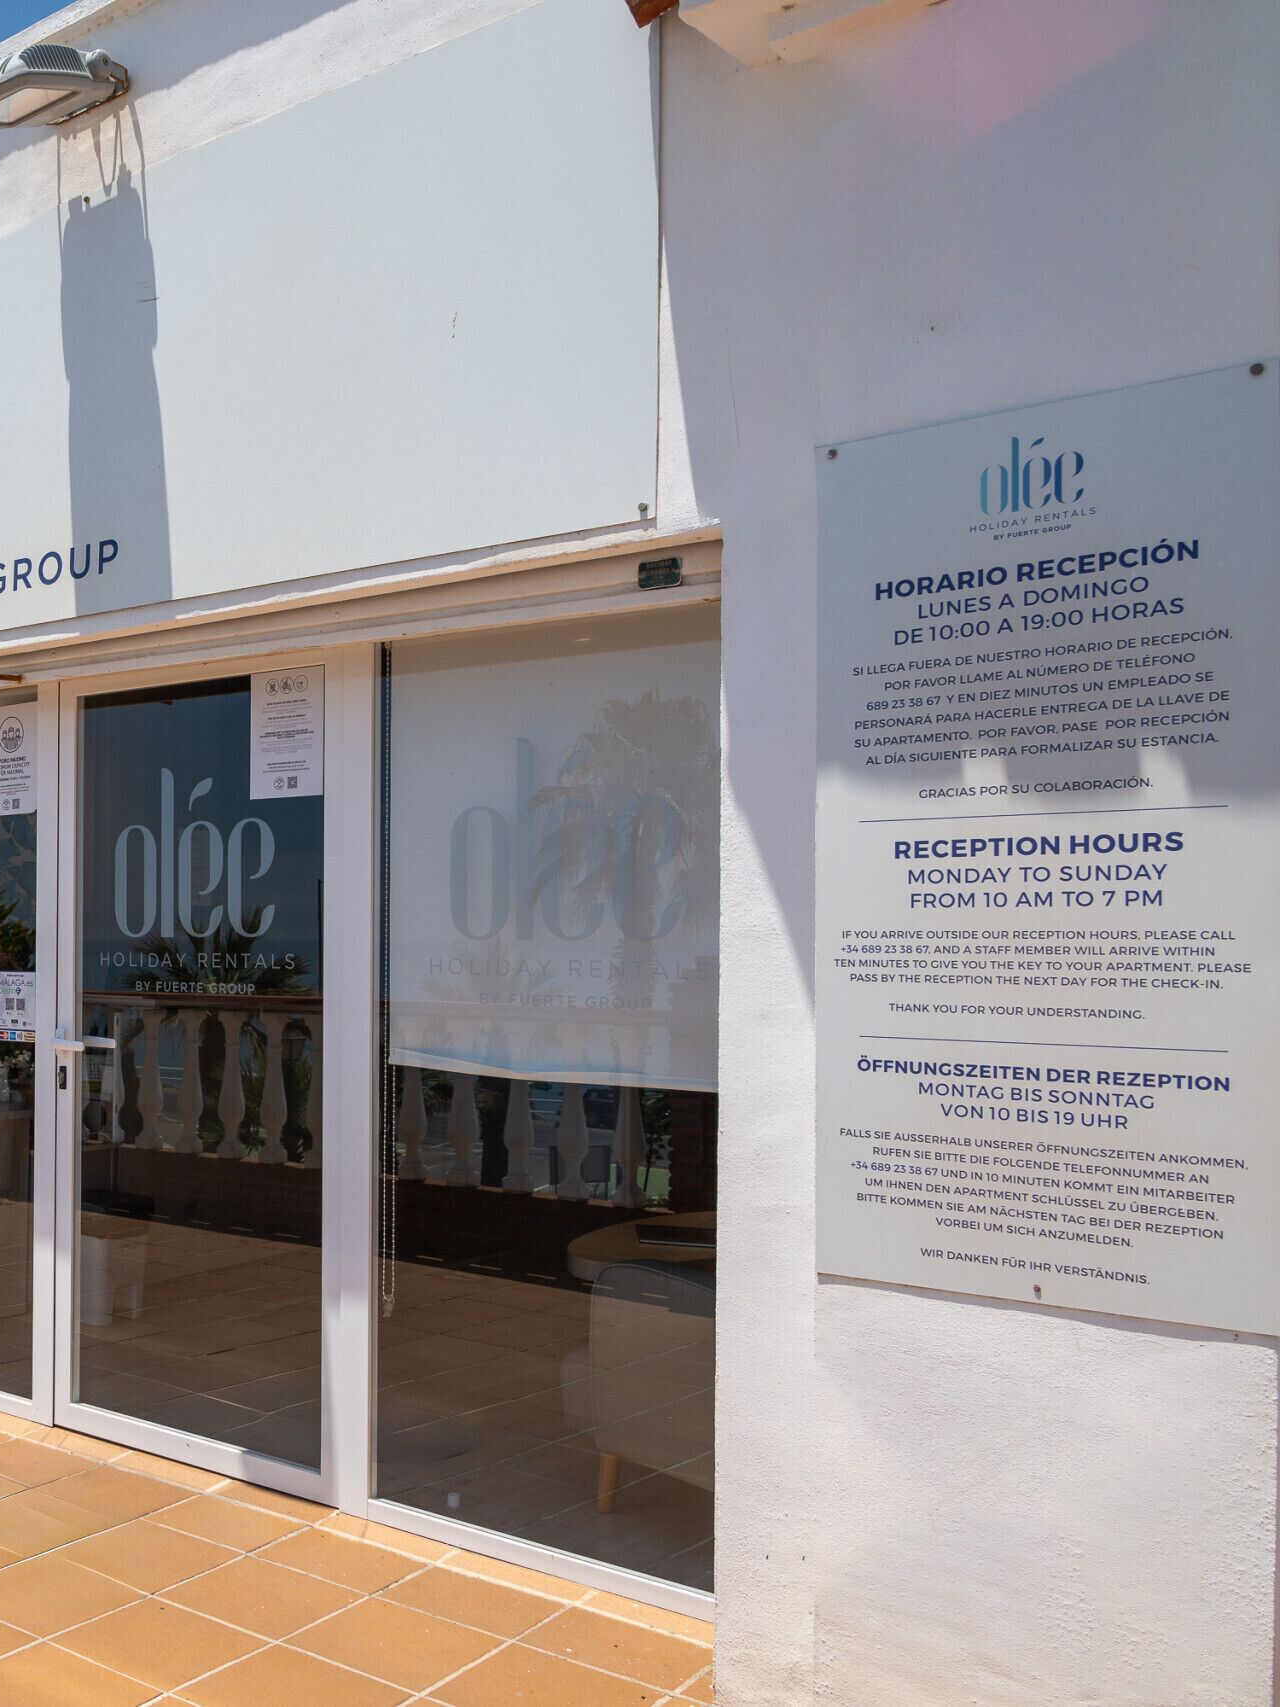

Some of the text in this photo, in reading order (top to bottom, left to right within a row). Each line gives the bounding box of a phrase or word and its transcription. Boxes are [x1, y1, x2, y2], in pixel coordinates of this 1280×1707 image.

[979, 436, 1084, 516] olée
[969, 506, 1097, 534] HOLIDAY RENTALS
[993, 523, 1073, 541] BY FUERTE GROUP
[875, 537, 1199, 602] HORARIO RECEPCIÓN
[918, 576, 1149, 620] LUNES A DOMINGO
[894, 597, 1185, 646] DE 10:00 A 19:00 HORAS
[852, 666, 864, 677] SI
[866, 662, 906, 676] LLEGA
[908, 657, 952, 671] FUERA
[954, 654, 973, 667] DE
[976, 648, 1042, 664] NUESTRO
[1044, 640, 1113, 657] HORARIO
[1116, 637, 1137, 650] DE
[884, 652, 1196, 692] POR FAVOR LLAME AL NÚMERO DE TELÉFONO
[853, 738, 871, 749] SU
[872, 730, 973, 748] APARTAMENTO.
[978, 727, 1007, 740] POR
[1061, 720, 1099, 734] PASE
[1105, 717, 1137, 730] POR
[1140, 709, 1230, 728] RECEPCIÓN
[865, 732, 1220, 766] AL DÍA SIGUIENTE PARA FORMALIZAR SU ESTANCIA.
[918, 775, 1154, 799] GRACIAS POR SU COLABORACIÓN.
[115, 767, 276, 938] olée
[894, 831, 1184, 860] RECEPTION HOURS
[908, 863, 1168, 885] MONDAY TO SUNDAY
[910, 889, 1163, 909] FROM 10 AM TO 7 PM
[842, 930, 852, 939] IF
[853, 930, 878, 940] YOU
[879, 930, 924, 940] ARRIVE
[925, 930, 979, 940] OUTSIDE
[981, 930, 1010, 940] OUR
[1012, 930, 1086, 940] RECEPTION
[1144, 930, 1197, 941] PLEASE
[1199, 930, 1236, 941] CALL
[100, 951, 295, 970] HOLIDAY RENTALS
[429, 957, 711, 981] HOLIDAY RENTALS
[135, 980, 255, 996] BY FUERTE GROUP
[850, 973, 1224, 990] PASS BY THE RECEPTION THE NEXT DAY FOR THE CHECK-IN.
[508, 993, 577, 1008] FUERTE
[585, 995, 652, 1010] GROUP
[888, 1002, 1146, 1020] THANK YOU FOR YOUR UNDERSTANDING.
[856, 1054, 1230, 1092] ÖFFNUNGSZEITEN DER REZEPTION
[918, 1081, 1155, 1110] MONTAG BIS SONNTAG
[939, 1103, 1128, 1130] VON 10 BIS 19 UHR
[839, 1127, 872, 1139] FALLS
[873, 1130, 892, 1141] SIE
[893, 1132, 972, 1147] AUSSERHALB
[974, 1138, 1034, 1152] UNSERER
[1036, 1141, 1155, 1162] ÖFFNUNGSZEITEN
[935, 1216, 1134, 1248] VORBEI UM SICH ANZUMELDEN.
[920, 1247, 1150, 1285] WIR DANKEN FÜR IHR VERSTÄNDNIS.
